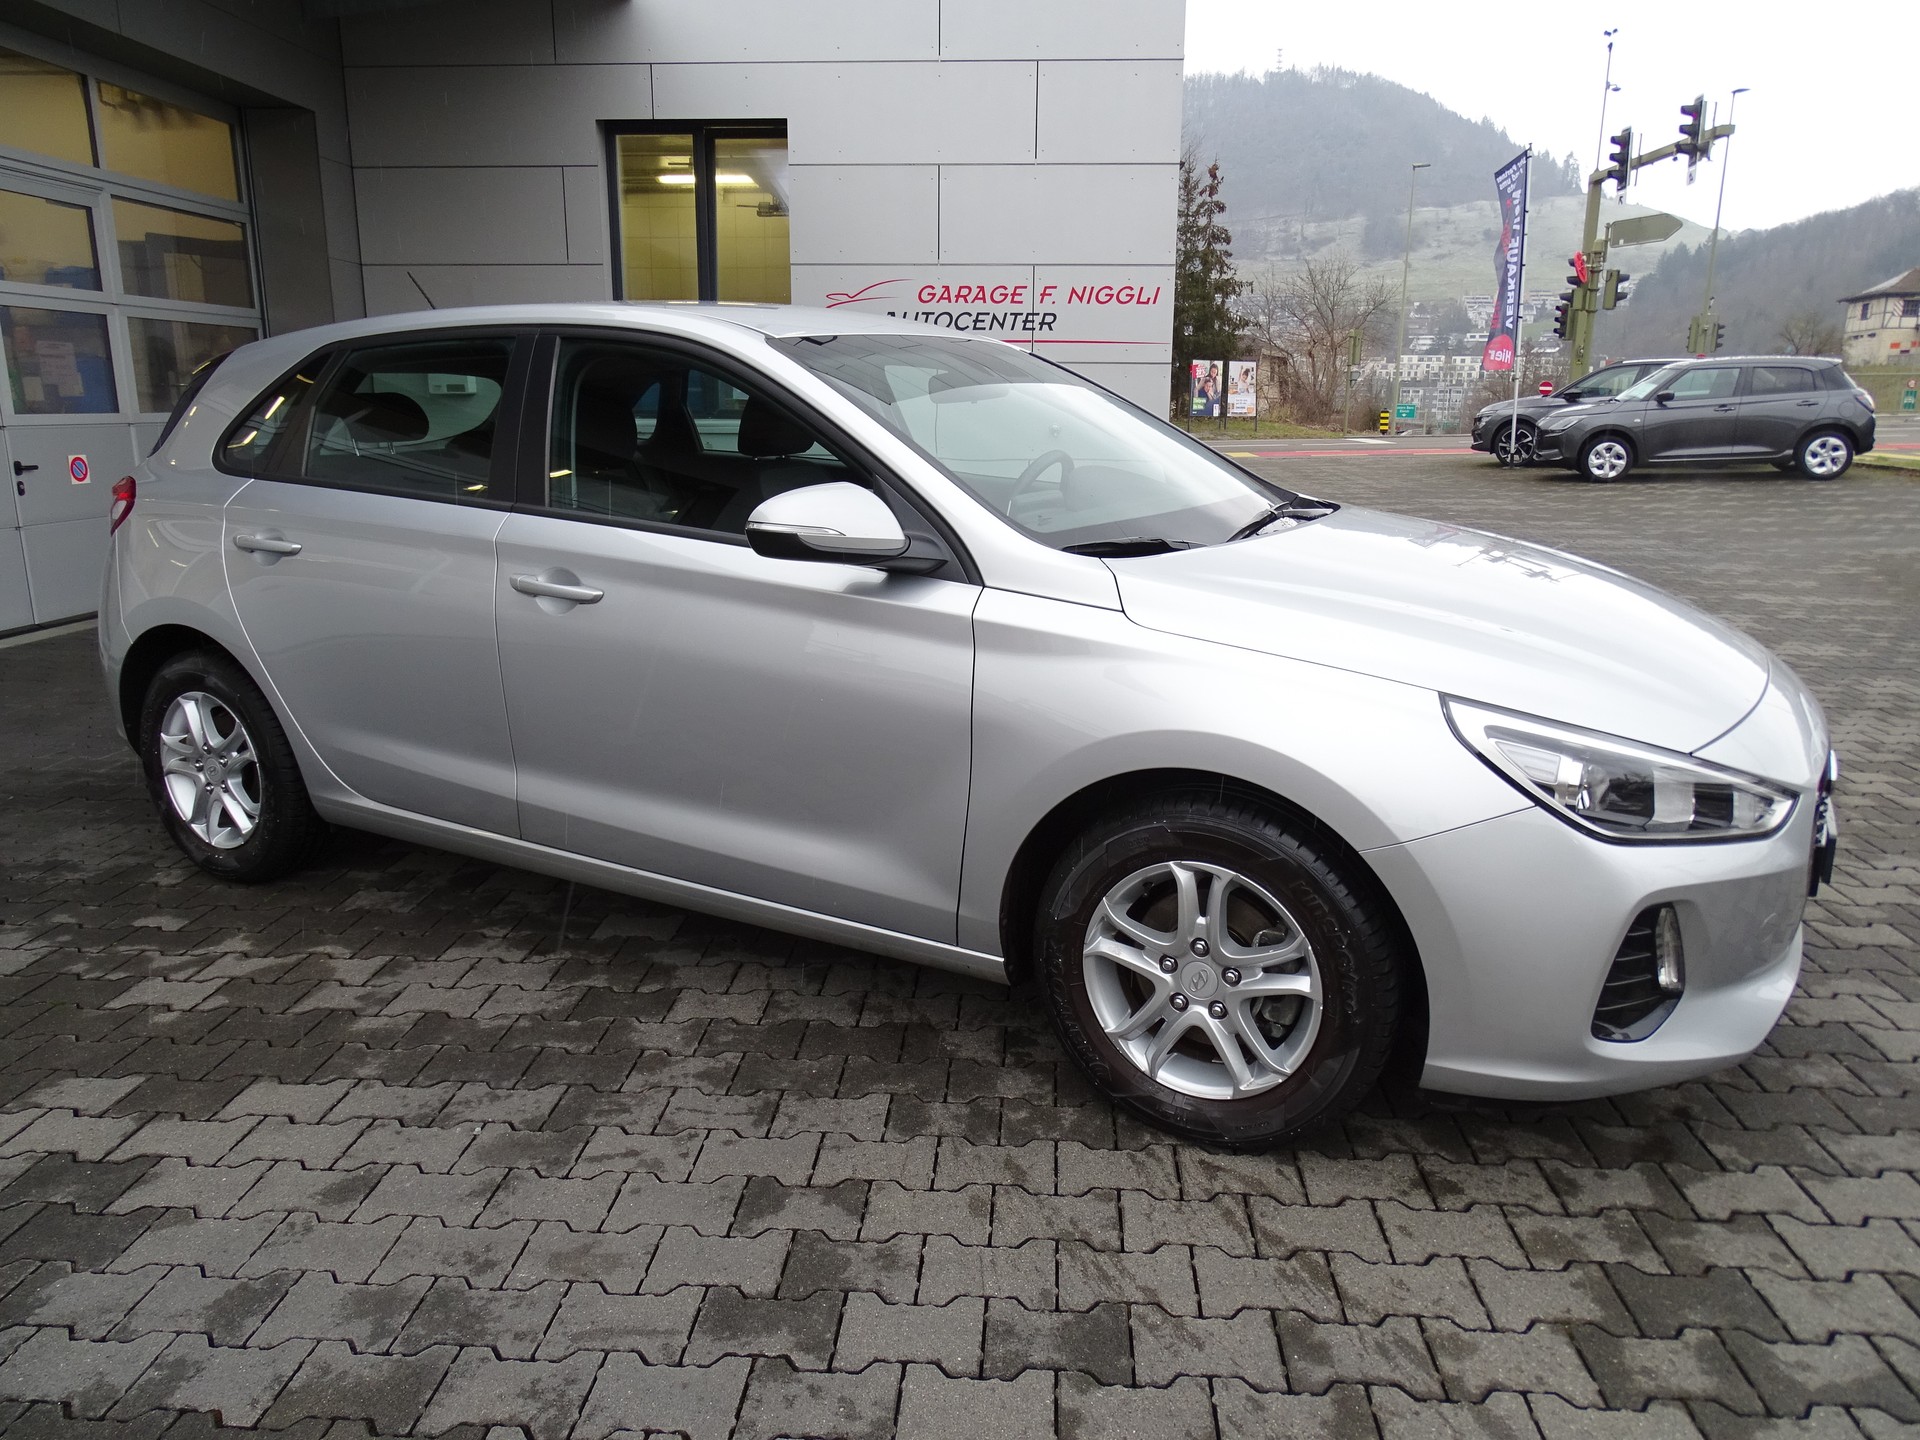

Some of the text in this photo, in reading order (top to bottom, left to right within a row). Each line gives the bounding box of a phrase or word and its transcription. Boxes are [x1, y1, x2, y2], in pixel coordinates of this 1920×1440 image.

[917, 284, 1161, 305] GARAGE F. NIGGLI
[886, 311, 1058, 331] TOCENTER
